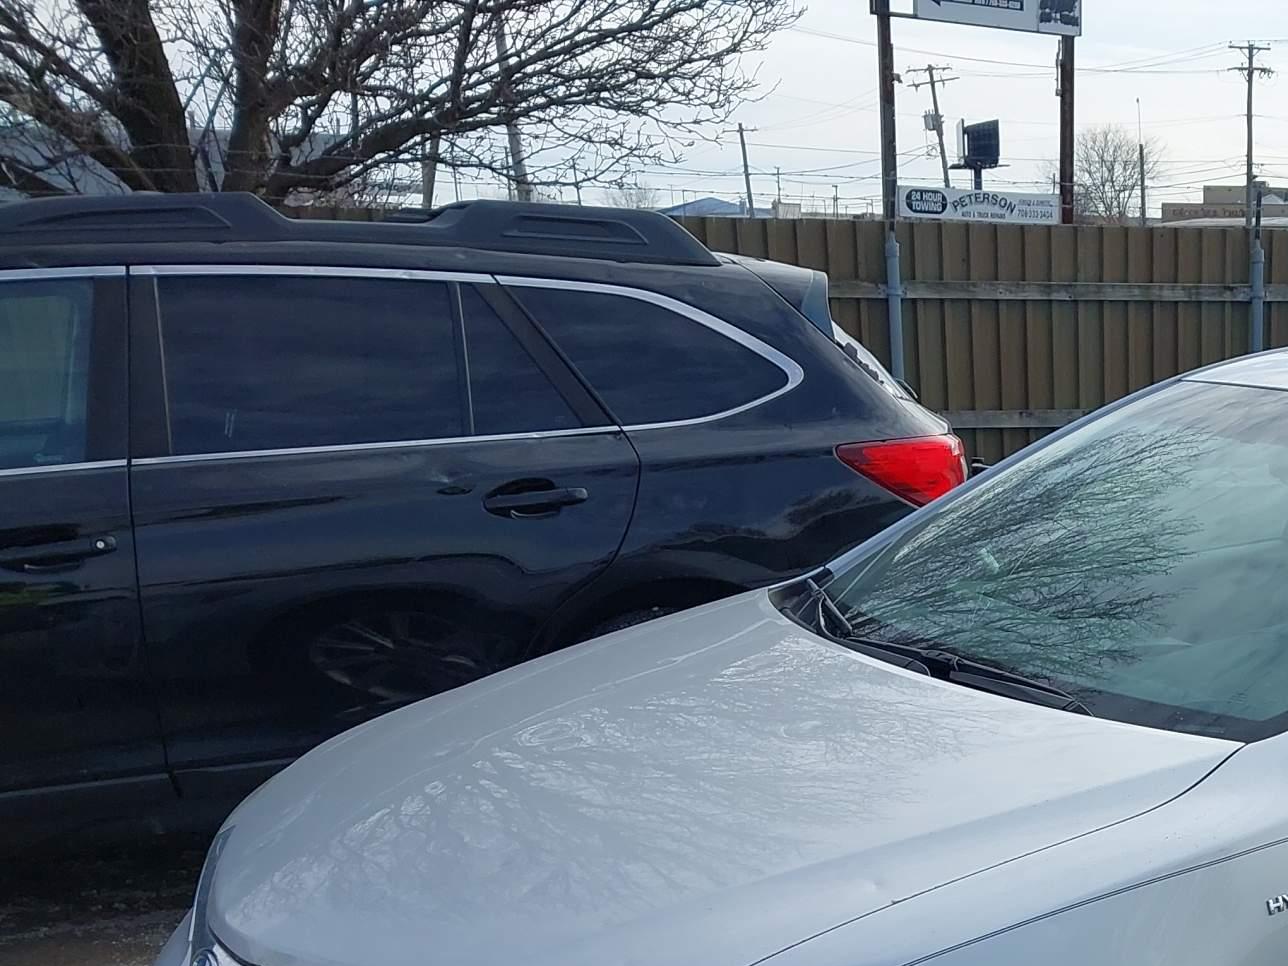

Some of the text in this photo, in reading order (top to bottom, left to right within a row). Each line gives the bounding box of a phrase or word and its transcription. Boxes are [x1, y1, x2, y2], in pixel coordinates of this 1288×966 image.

[911, 191, 943, 202] 24 HOUR
[911, 201, 943, 211] TOWING
[952, 192, 1017, 214] PETERSON
